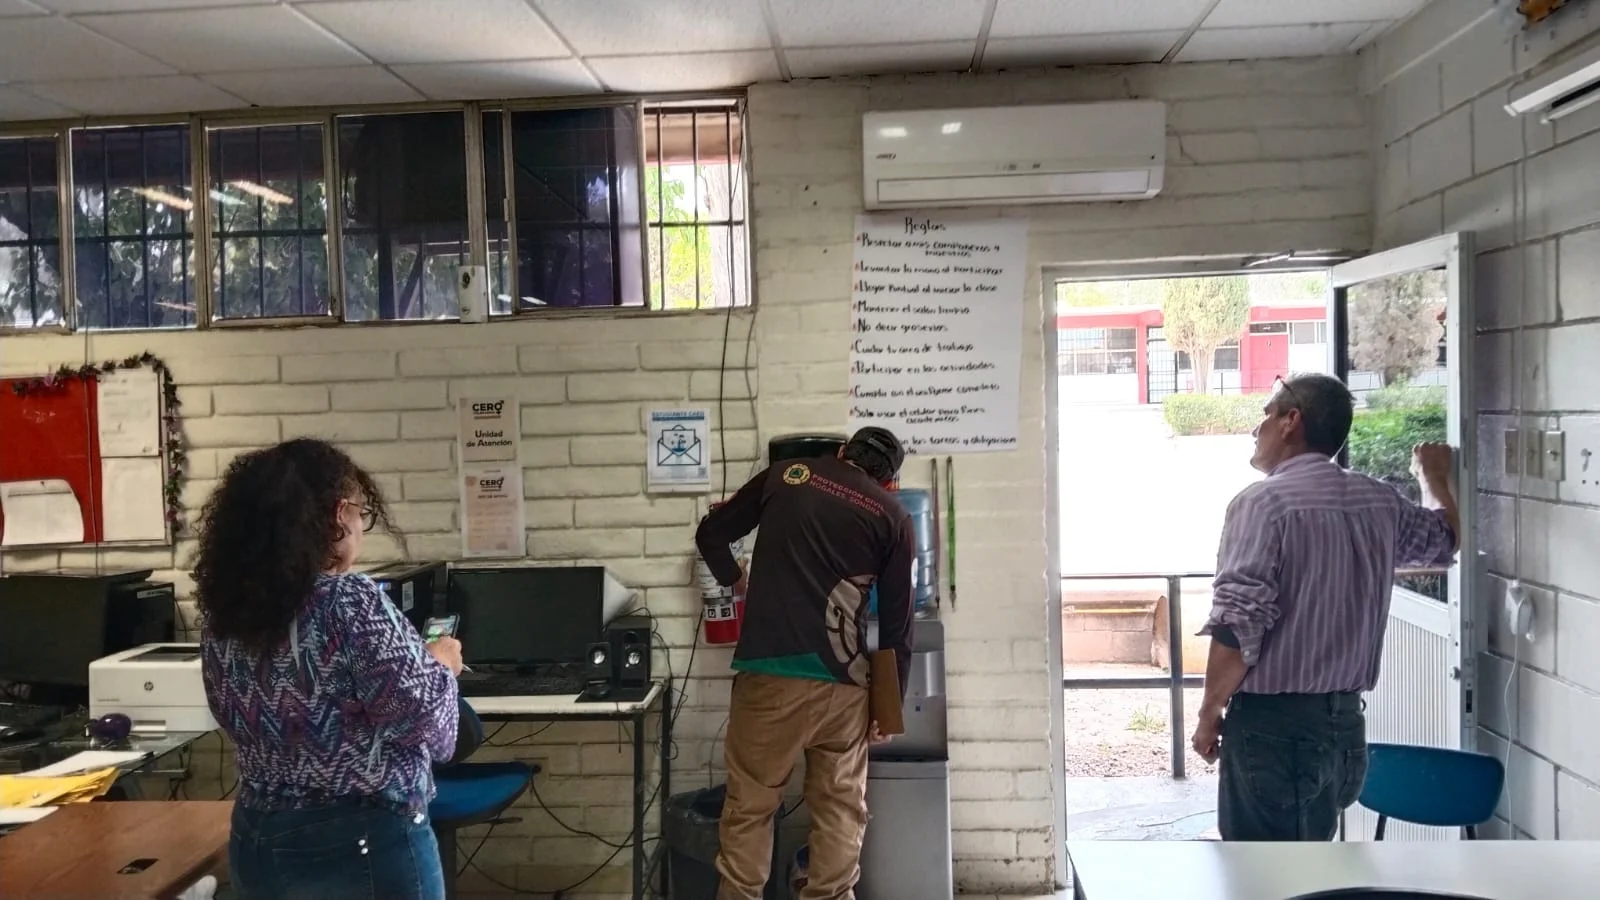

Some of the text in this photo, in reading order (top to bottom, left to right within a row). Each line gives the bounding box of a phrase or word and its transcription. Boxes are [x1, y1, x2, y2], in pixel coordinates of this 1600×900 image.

[904, 217, 946, 235] Reglas
[902, 304, 911, 313] el
[857, 318, 871, 332] No
[472, 402, 503, 412] CERO
[475, 430, 503, 438] Unidad
[480, 479, 503, 487] CERO
[810, 480, 845, 498] NOGALES
